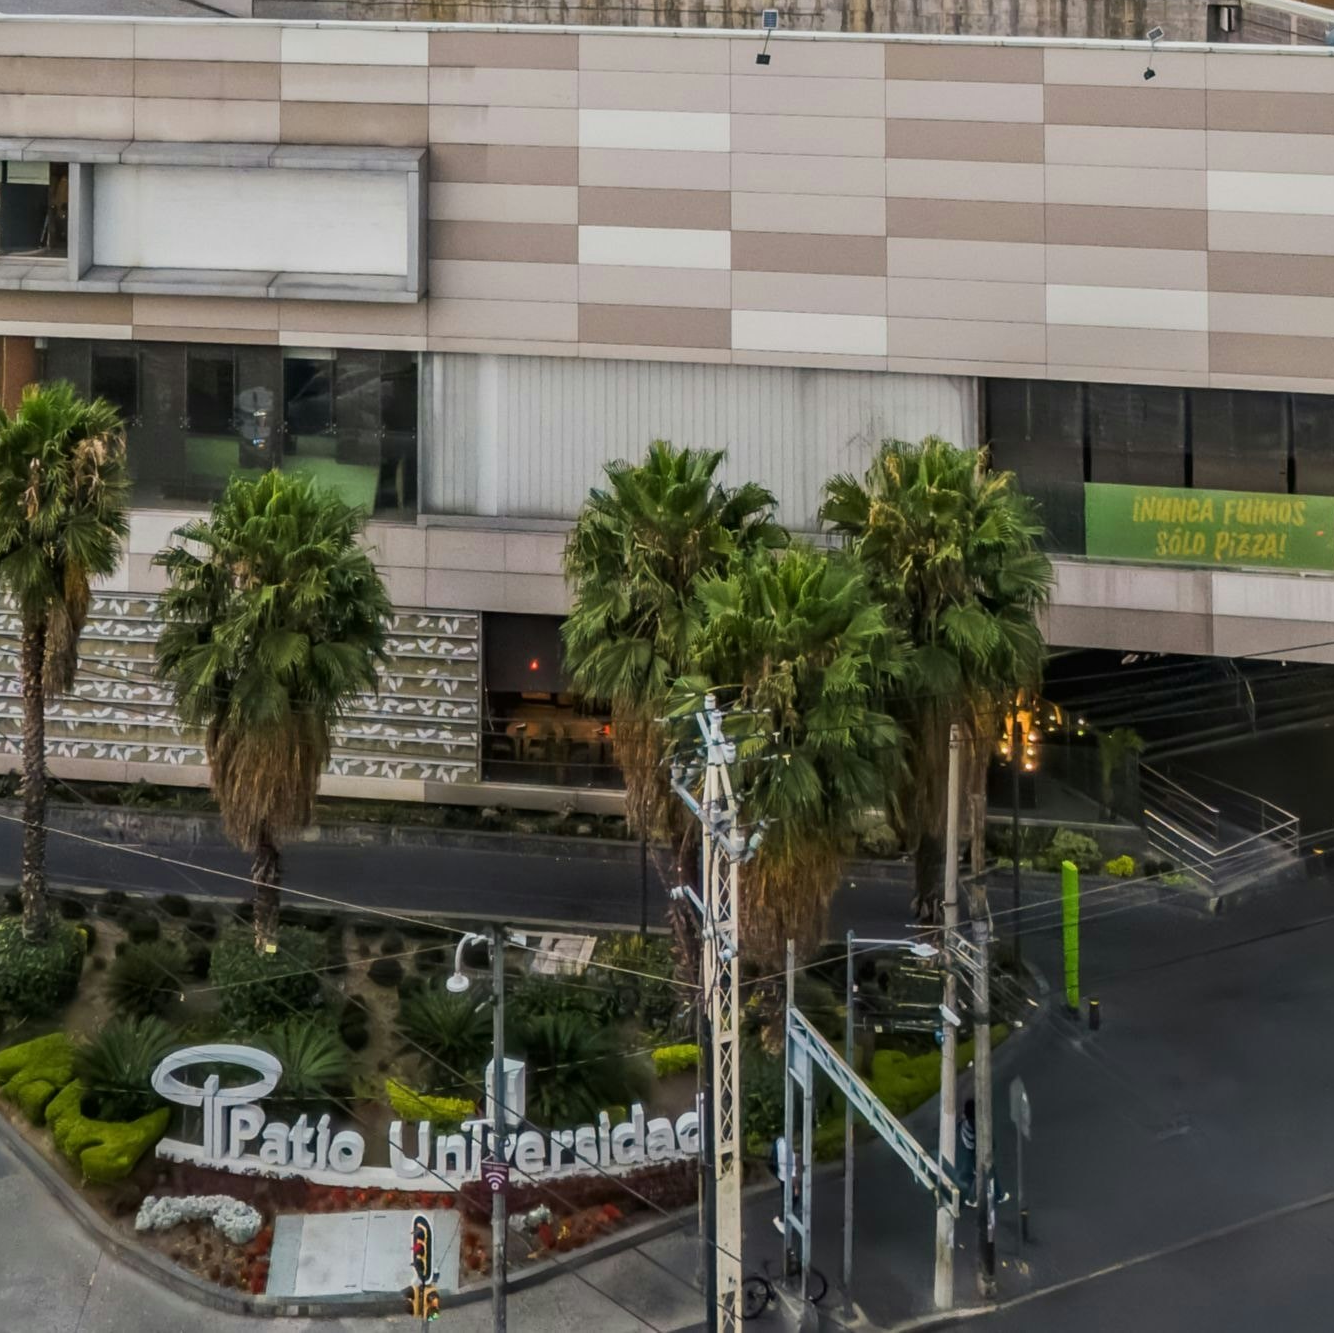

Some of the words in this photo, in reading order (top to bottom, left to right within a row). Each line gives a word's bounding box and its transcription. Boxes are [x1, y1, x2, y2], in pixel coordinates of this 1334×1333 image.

[1156, 528, 1207, 556] SÓLO
[227, 1104, 365, 1174] Patio
[389, 1092, 703, 1180] Universidad
